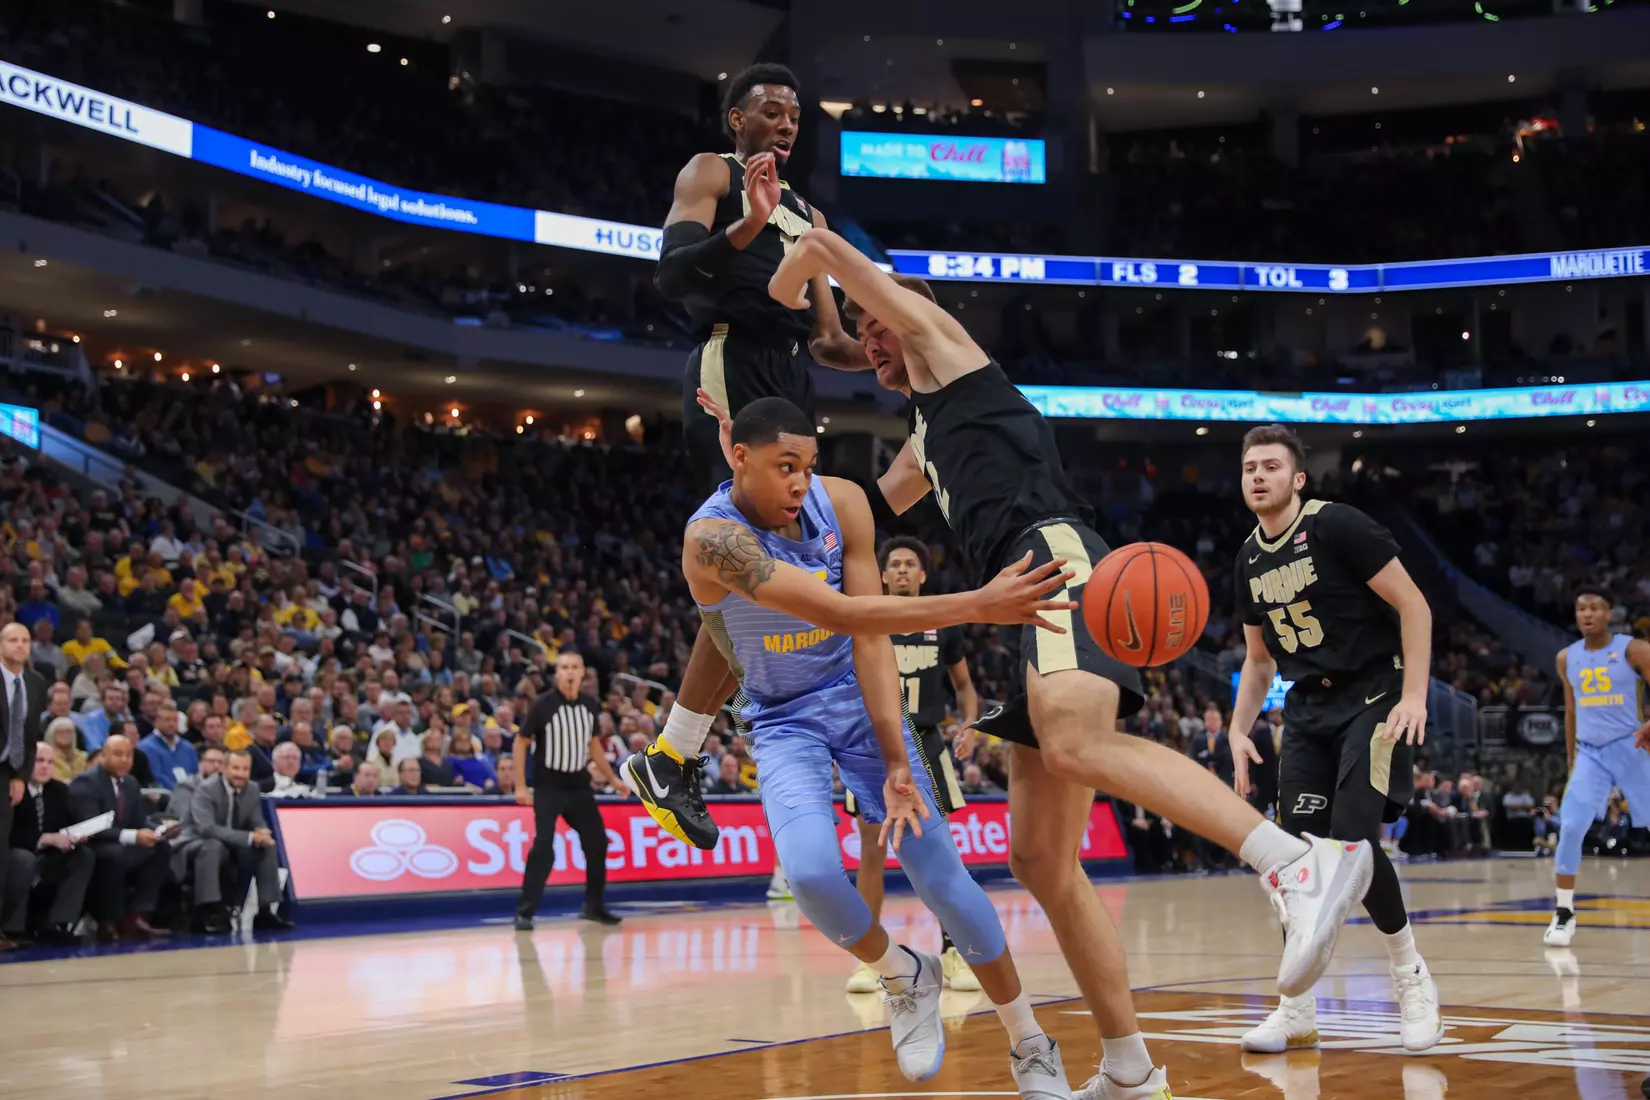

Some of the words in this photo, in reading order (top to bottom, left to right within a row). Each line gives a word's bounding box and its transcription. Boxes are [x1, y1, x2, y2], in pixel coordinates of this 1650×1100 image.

[929, 141, 989, 163] Chill
[250, 149, 313, 188] Industry
[313, 168, 366, 201] focused
[367, 185, 399, 212] legal
[400, 198, 477, 224] solutions.
[928, 253, 995, 278] 8:34
[1001, 256, 1045, 280] PM
[1112, 262, 1158, 284] FLS
[1178, 263, 1199, 287] 2
[1551, 250, 1645, 279] MARQUETTE
[1254, 265, 1303, 288] TOL
[1328, 268, 1349, 291] 3
[1249, 556, 1318, 604] PURDUE
[1267, 600, 1325, 654] 55
[1580, 667, 1612, 693] 25
[1292, 793, 1328, 814] P
